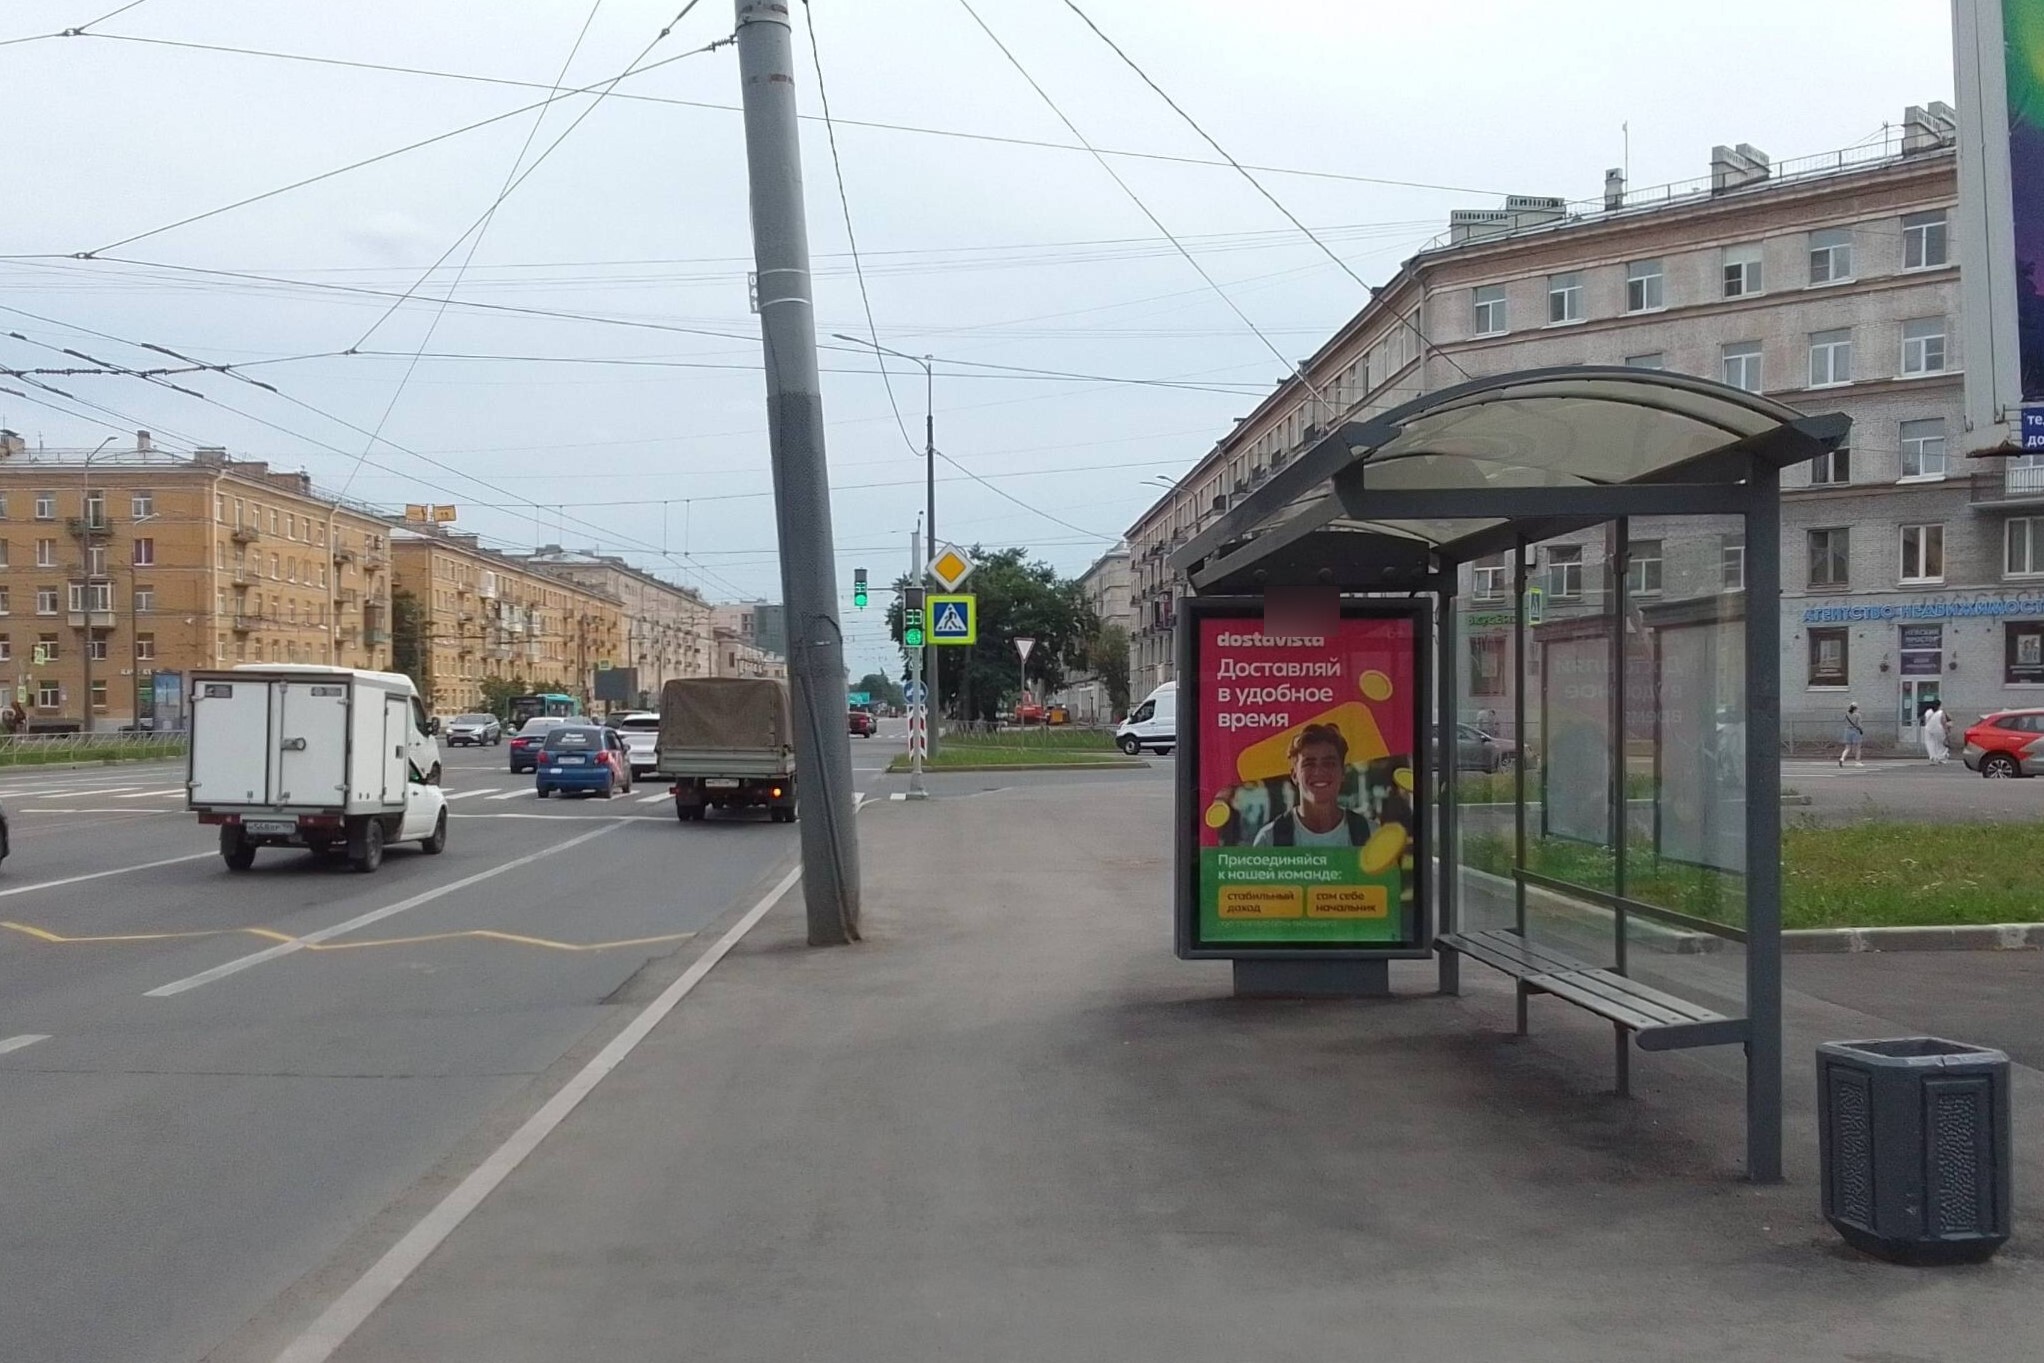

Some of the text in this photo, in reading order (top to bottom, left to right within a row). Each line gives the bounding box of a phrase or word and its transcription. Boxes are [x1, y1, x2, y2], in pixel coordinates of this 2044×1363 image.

[750, 275, 758, 312] 041
[2027, 414, 2044, 426] те
[906, 609, 923, 625] 33
[1803, 604, 1894, 623] АГЕНТСТВО
[1217, 631, 1324, 647] dostavista
[1217, 657, 1341, 680] Доставляй
[1218, 683, 1333, 706] в удобное
[1218, 712, 1289, 731] время
[1218, 853, 1327, 867] Присоединяйся
[1218, 867, 1342, 881] к нашей команде:
[1227, 891, 1294, 901] стабильный
[1316, 891, 1364, 901] сам себе
[1227, 904, 1261, 913] доход
[1316, 904, 1376, 913] начальник
